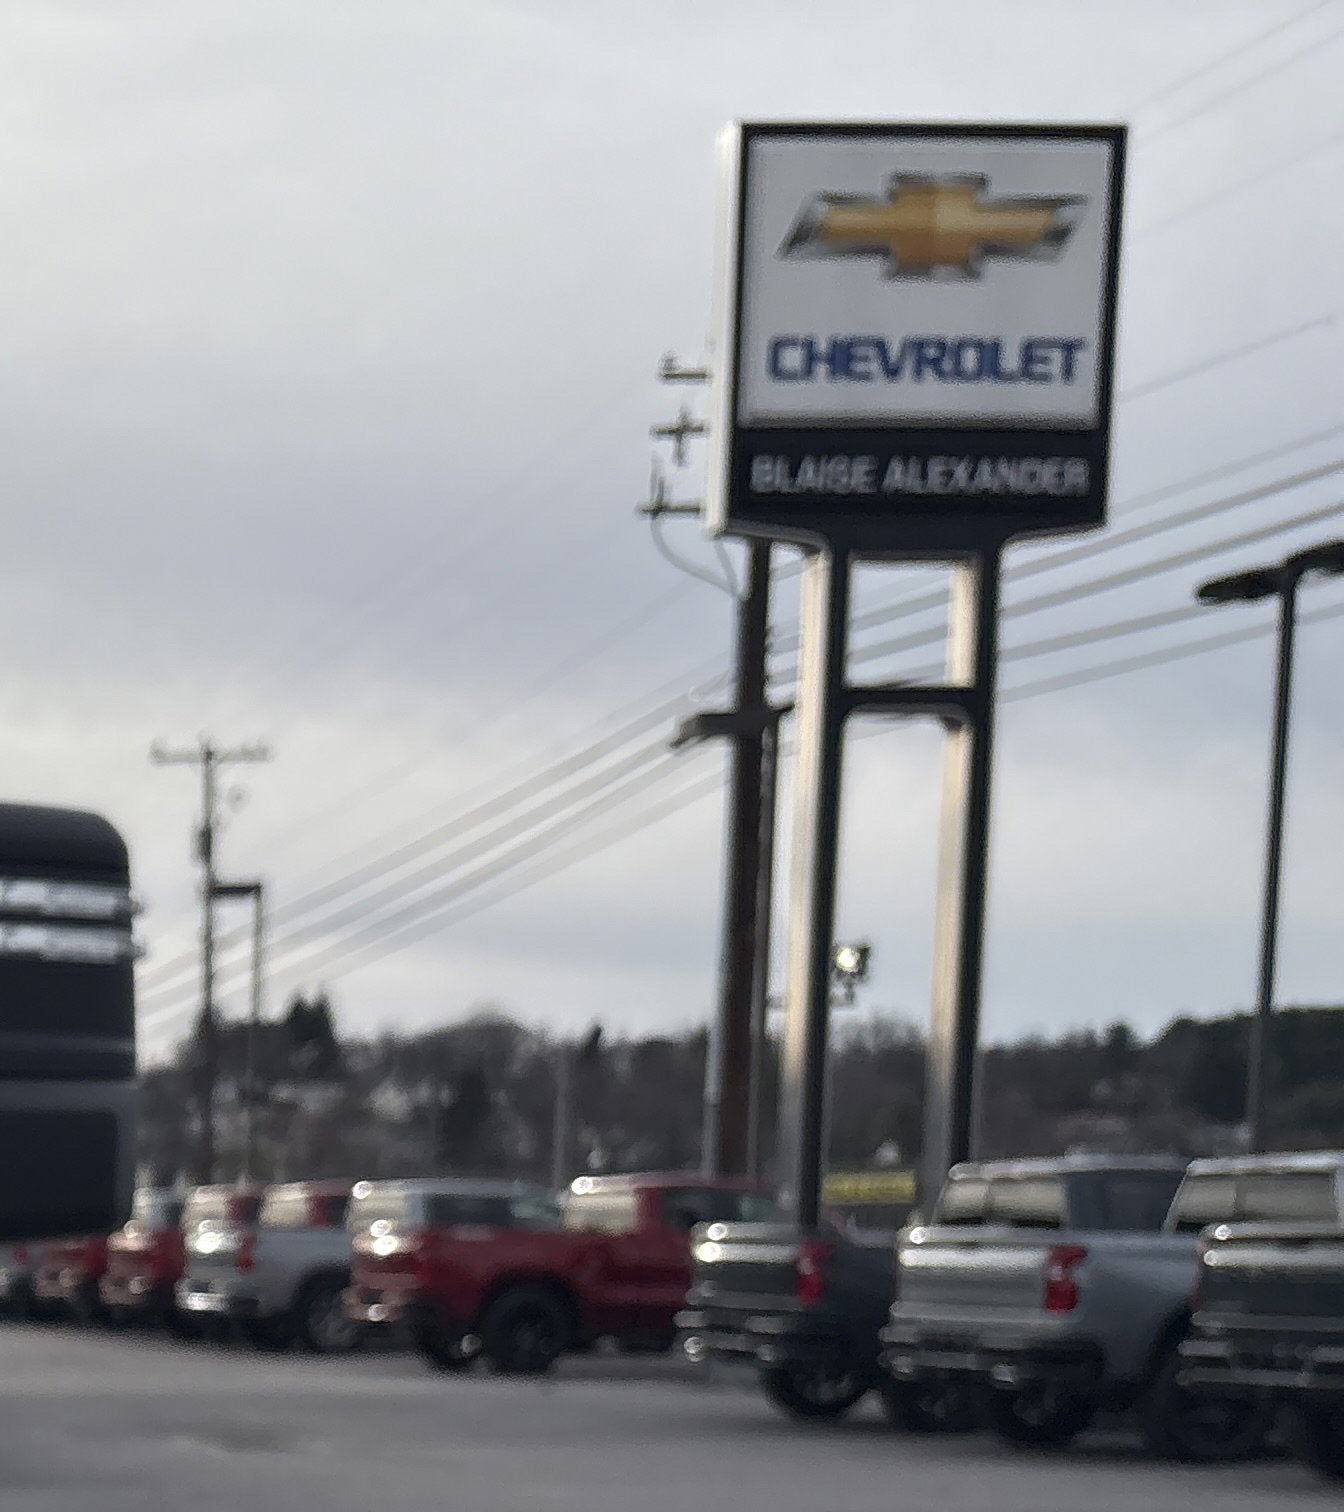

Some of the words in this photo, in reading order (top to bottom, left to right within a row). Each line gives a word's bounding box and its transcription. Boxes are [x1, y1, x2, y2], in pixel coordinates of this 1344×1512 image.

[768, 335, 1086, 383] CHEVROLET
[749, 454, 879, 494] BLAISE
[881, 455, 1090, 496] ALEXANDER
